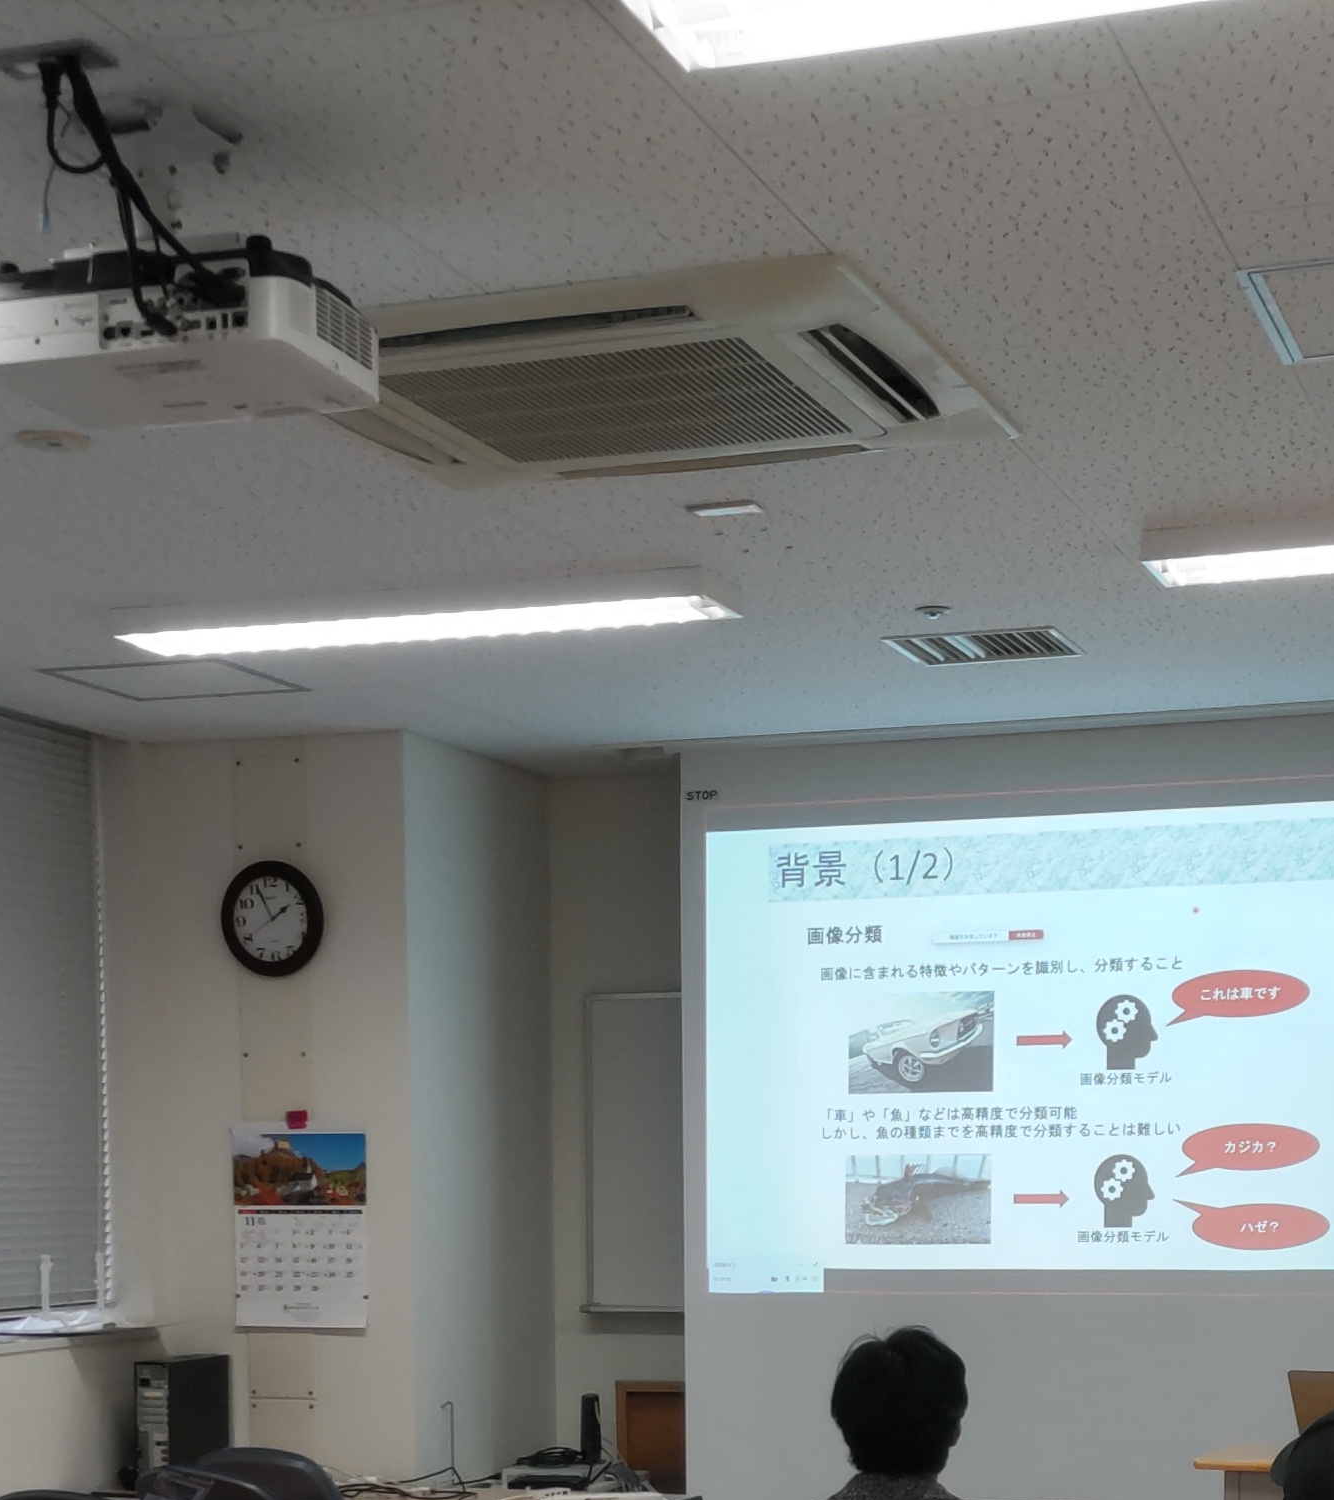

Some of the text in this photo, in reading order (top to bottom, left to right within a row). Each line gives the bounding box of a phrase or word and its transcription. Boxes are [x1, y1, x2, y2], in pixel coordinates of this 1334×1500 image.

[686, 789, 718, 801] STOP
[807, 925, 883, 945] 画像分類
[820, 956, 1183, 981] 画像に含まれる特徴やパターンを識別し、分類すること
[1199, 985, 1281, 1000] これは車です
[1080, 1071, 1172, 1086] 画像分類モデル
[827, 1106, 1078, 1122] 「車」や「魚」などは高精度で分類可能
[822, 1122, 1181, 1139] しかし、魚の種類までを高精度で分類することは難しい
[1077, 1230, 1169, 1243] 画像分類モデル
